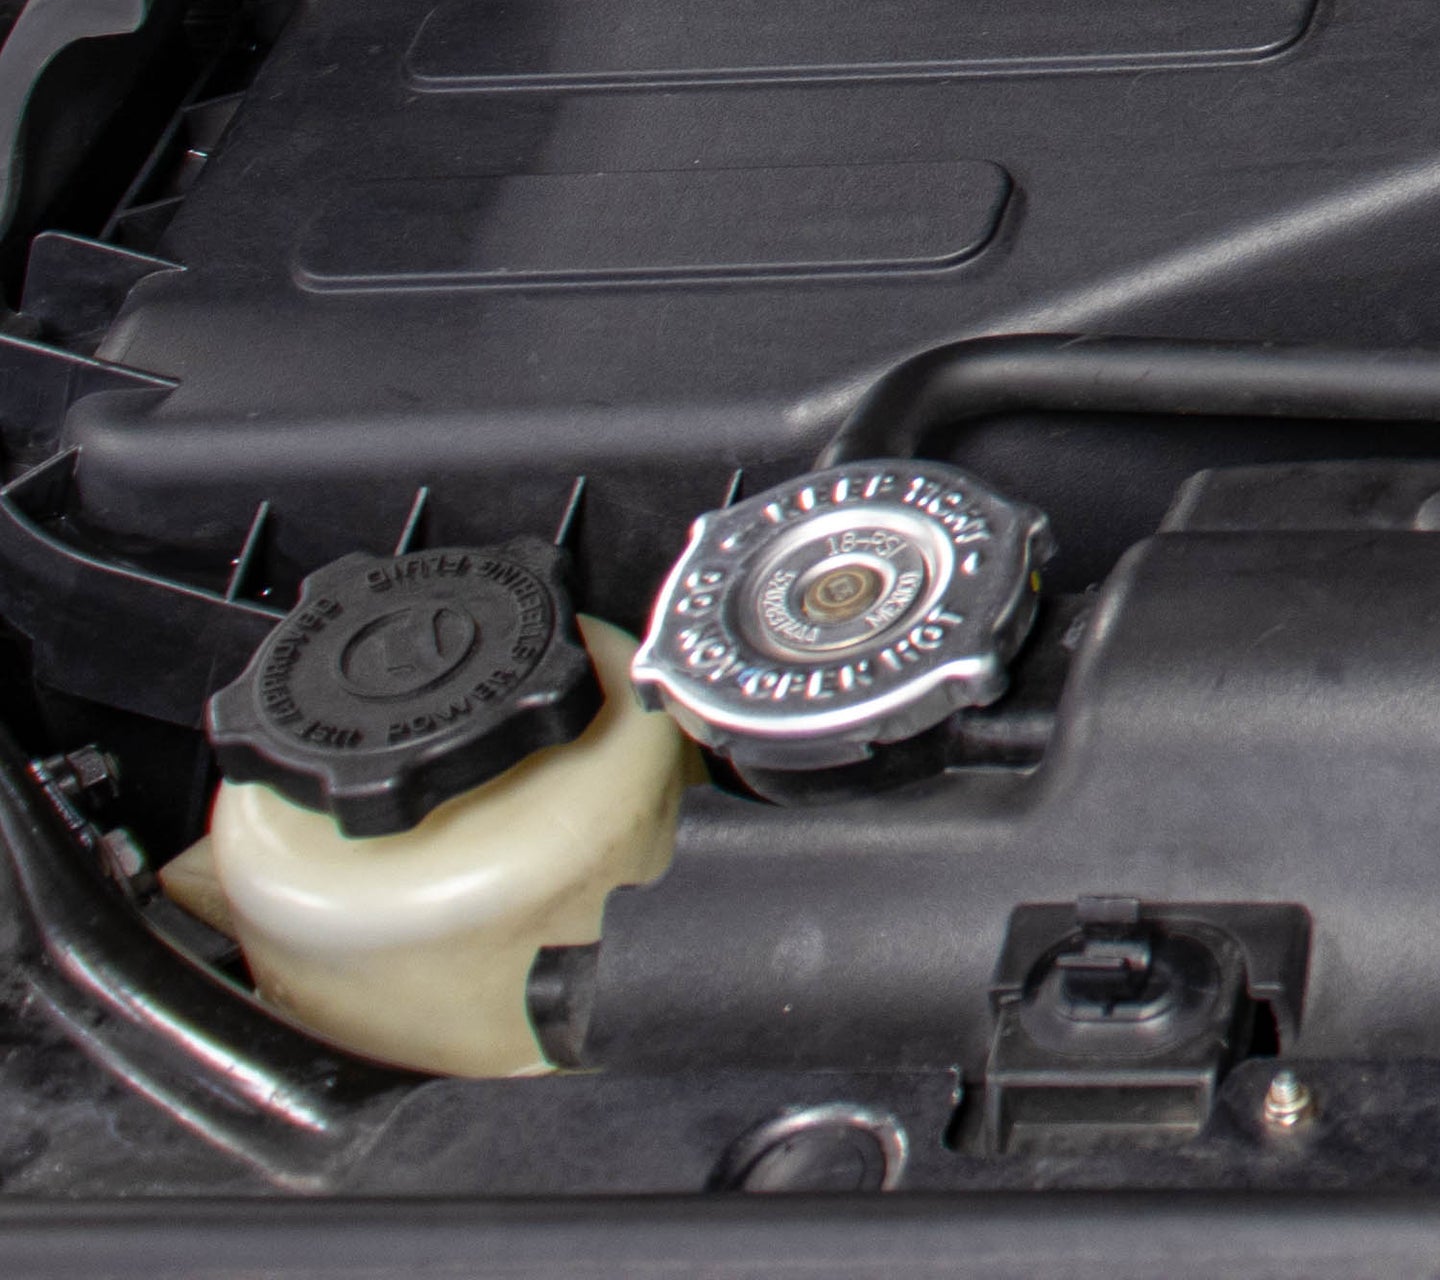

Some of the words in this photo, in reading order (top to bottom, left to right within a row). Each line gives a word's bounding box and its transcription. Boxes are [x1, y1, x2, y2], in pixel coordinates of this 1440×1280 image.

[366, 555, 471, 592] FLUID
[866, 569, 922, 631] MEXICO
[475, 556, 548, 664] STEERING
[386, 668, 516, 744] POWER
